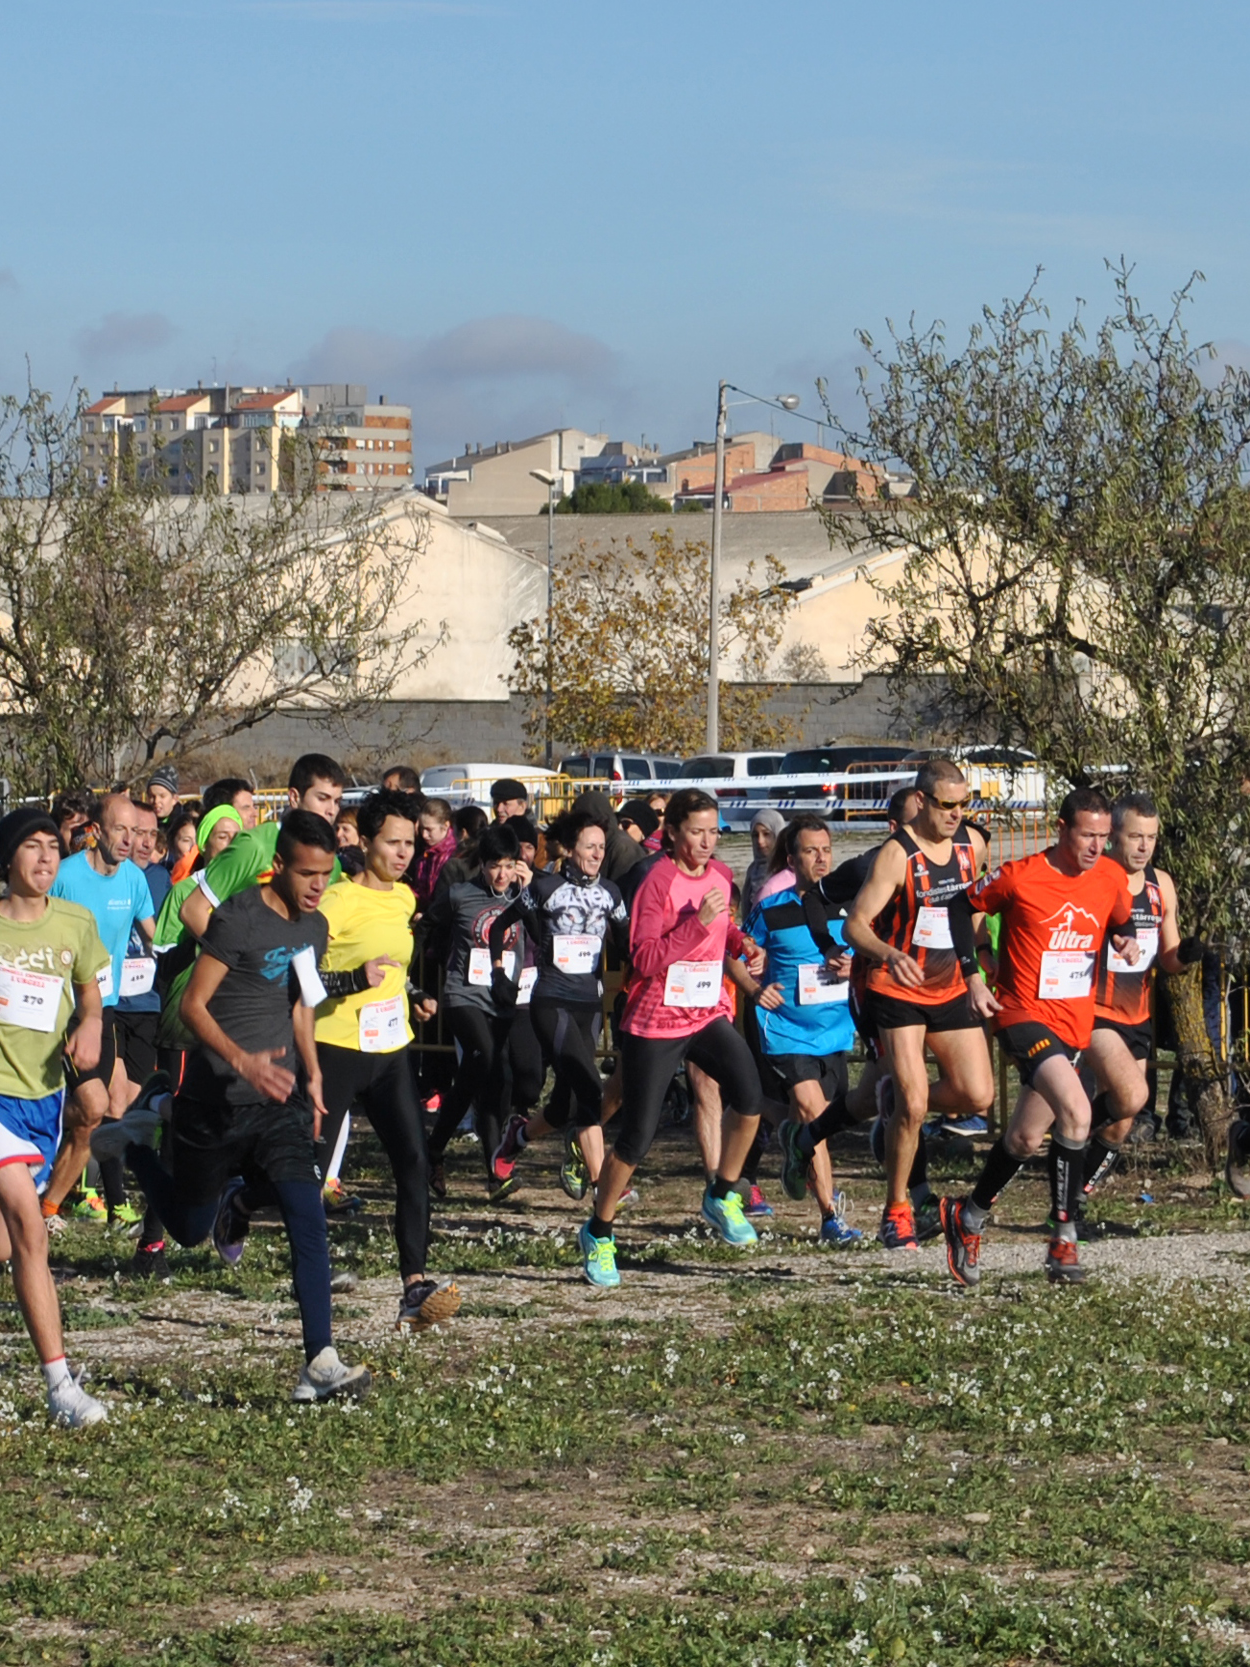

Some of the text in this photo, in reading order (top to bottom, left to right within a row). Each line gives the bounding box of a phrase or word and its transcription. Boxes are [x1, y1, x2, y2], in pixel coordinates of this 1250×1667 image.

[1048, 930, 1094, 950] Ultra
[696, 981, 711, 989] 499
[22, 994, 44, 1005] 270
